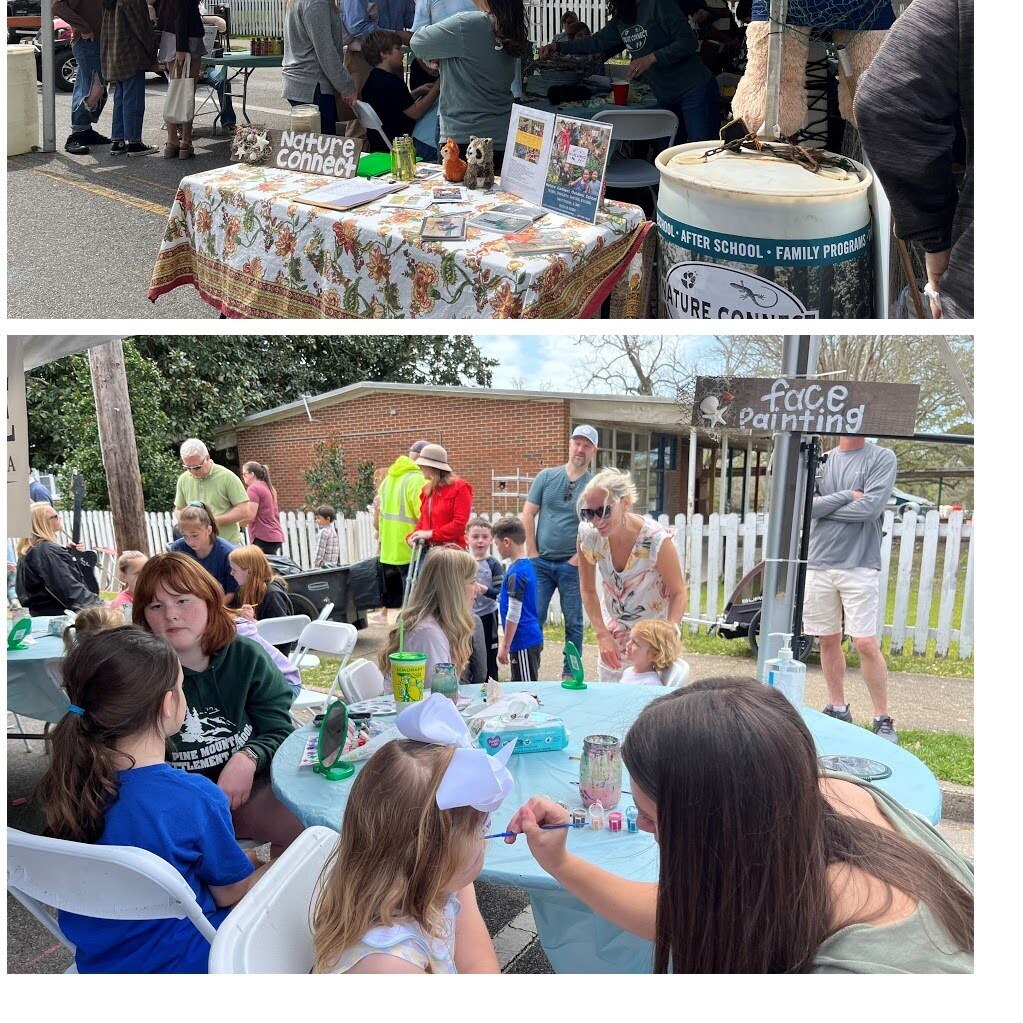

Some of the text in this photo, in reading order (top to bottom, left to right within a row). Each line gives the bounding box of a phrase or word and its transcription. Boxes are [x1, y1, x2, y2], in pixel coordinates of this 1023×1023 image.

[680, 229, 711, 250] AFTER
[713, 238, 764, 259] SCHOOL
[776, 245, 820, 261] FAMILY
[823, 233, 867, 258] PROGRAMS
[739, 404, 865, 434] Painting
[171, 749, 198, 761] PINE
